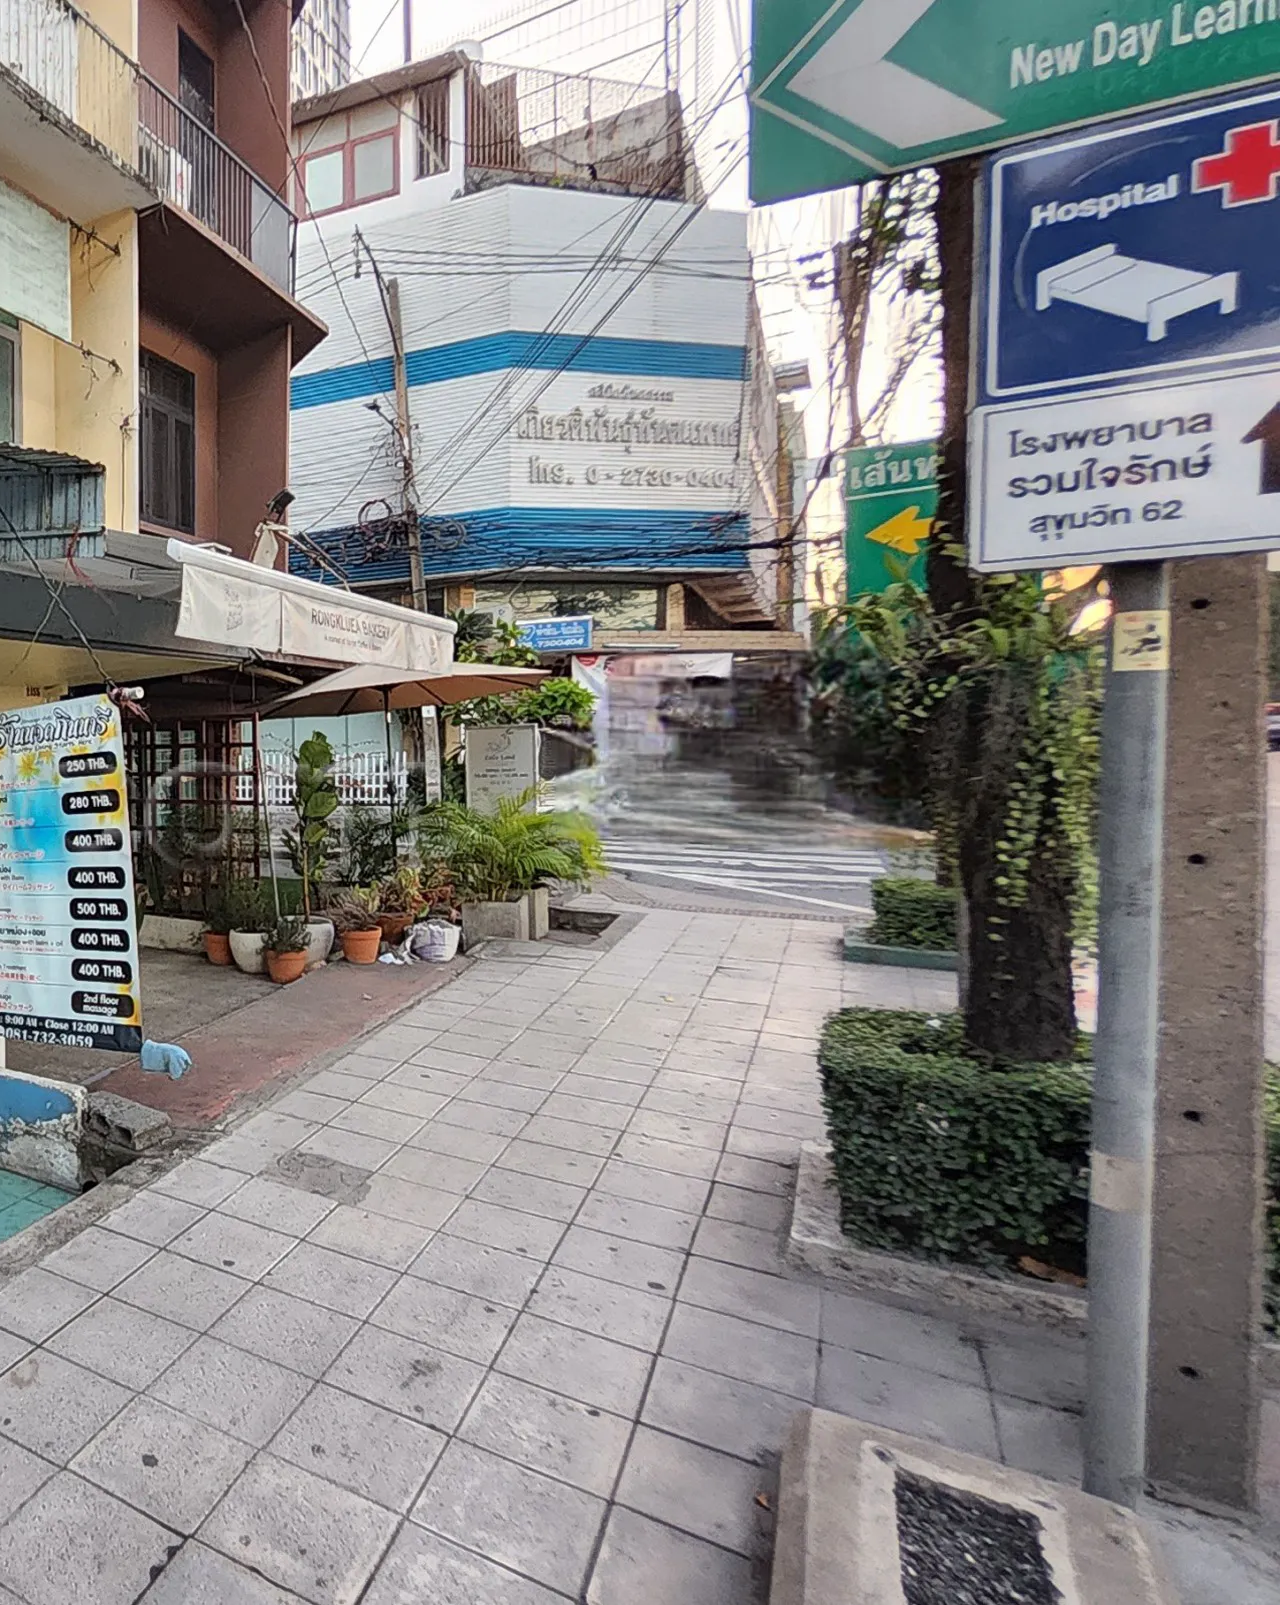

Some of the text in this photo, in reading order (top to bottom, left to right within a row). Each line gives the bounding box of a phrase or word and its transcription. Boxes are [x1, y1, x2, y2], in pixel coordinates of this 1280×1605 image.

[1010, 0, 1280, 90] New Day Learn
[1031, 174, 1181, 230] Hospital
[1008, 412, 1213, 458] โรงพยาบาล
[1007, 442, 1213, 499] รวมใจรักษ์
[1029, 500, 1183, 543] สุขุมวิท 62
[311, 608, 361, 635] RONGKLUEA
[66, 757, 109, 772] 250 THB.
[69, 795, 113, 809] 280 THB.
[72, 834, 116, 846] 400 THB.
[75, 871, 119, 883] 400 THB.
[77, 903, 121, 916] 500 THB.
[78, 933, 124, 947] 400 THB.
[79, 964, 126, 978] 400 THB.
[83, 993, 119, 1005] 2nd floor
[83, 1003, 117, 1016] massage
[5, 1015, 24, 1027] 9:00
[26, 1018, 38, 1028] AM
[45, 1020, 69, 1031] Close
[72, 1022, 98, 1034] 12:00
[100, 1025, 115, 1036] AM
[5, 1029, 94, 1048] 081-732-3059
